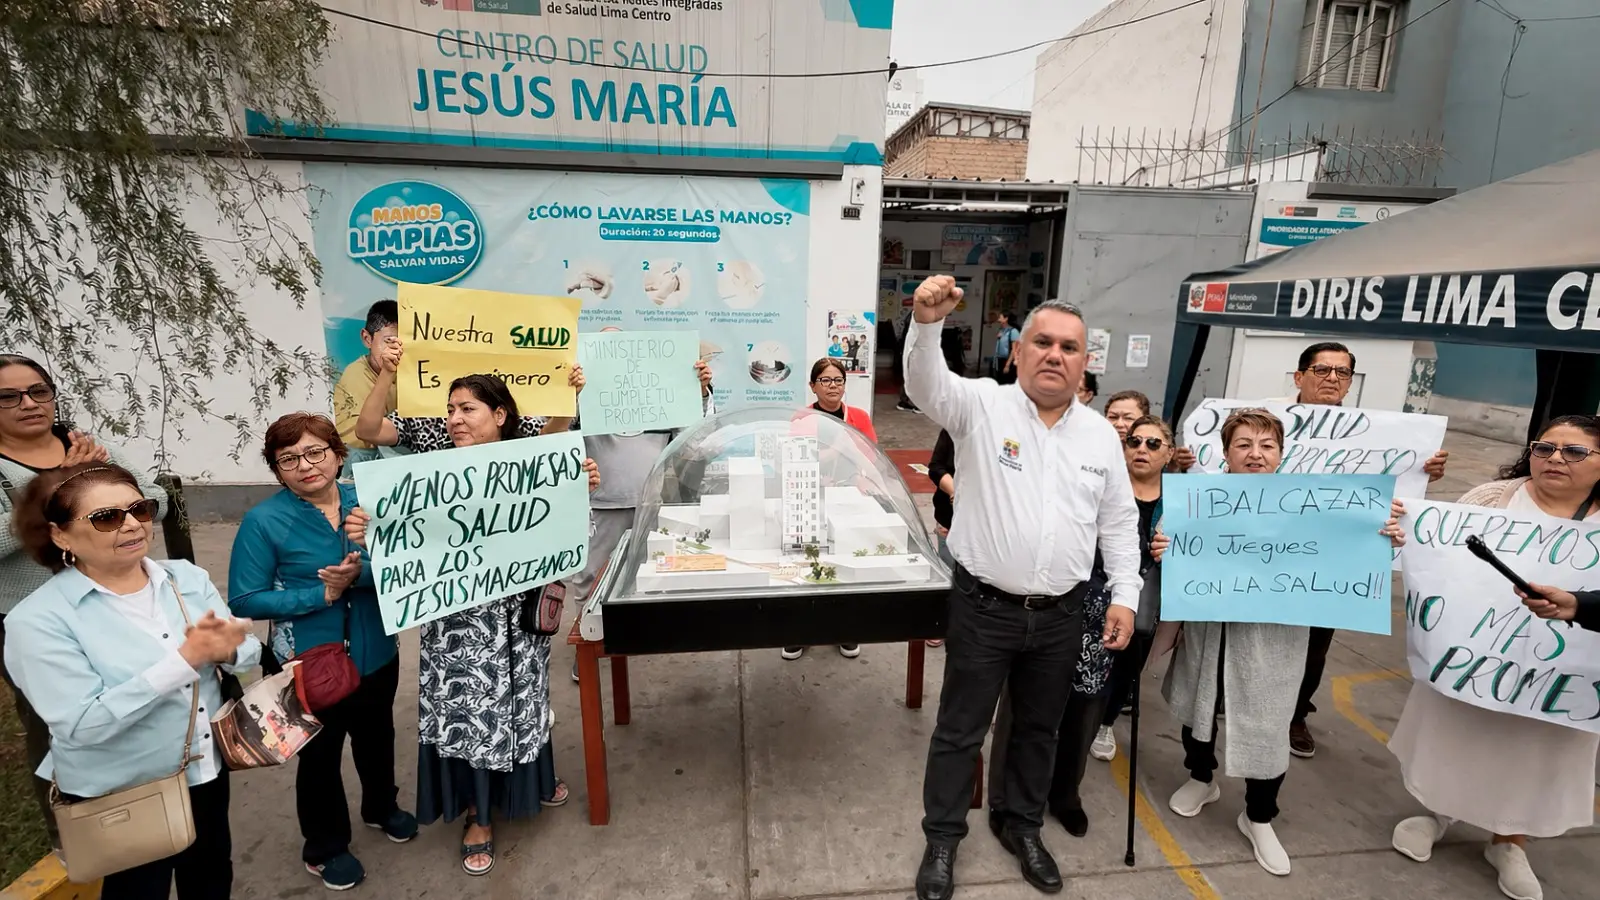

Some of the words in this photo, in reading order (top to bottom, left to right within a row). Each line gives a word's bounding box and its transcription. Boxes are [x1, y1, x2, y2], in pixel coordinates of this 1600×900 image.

[547, 2, 562, 14] de
[565, 3, 597, 17] Salud
[600, 5, 629, 19] Lima
[632, 7, 671, 22] Centro
[436, 28, 557, 64] CENTRO
[567, 37, 604, 67] DE
[613, 40, 708, 73] SALUD
[413, 62, 556, 119] JESÚS
[571, 73, 737, 127] MARÍA
[372, 204, 443, 224] MANOS
[527, 201, 593, 221] ¿CÓMO
[597, 207, 678, 222] LAVARSE
[682, 209, 715, 223] LAS
[720, 210, 793, 226] MANOS?
[348, 222, 473, 256] LIMPIAS
[600, 227, 651, 238] Duración:
[653, 229, 666, 238] 20
[379, 257, 426, 269] SALVAN
[429, 255, 465, 266] VIDAS
[563, 260, 569, 269] 1
[642, 261, 650, 270] 2
[717, 263, 724, 272] 3
[1236, 302, 1253, 311] Salud
[1290, 275, 1385, 322] DIRIS
[1401, 274, 1516, 328] LIMA
[510, 325, 571, 347] SALUD
[584, 339, 676, 360] MINISTERIO
[747, 343, 754, 352] 7
[417, 359, 442, 389] Es
[626, 360, 642, 374] DE
[613, 372, 660, 390] SALUD
[600, 388, 653, 407] CUMPLE
[655, 387, 675, 404] TU
[604, 406, 668, 428] PROMESA
[1285, 404, 1371, 441] SALUD
[376, 466, 477, 519] MENOS
[484, 447, 581, 499] PROMESAS
[370, 515, 425, 557] MÁS
[447, 497, 551, 547] SALUD
[1413, 506, 1600, 570] QUEREMOS
[1171, 531, 1204, 557] NO
[380, 559, 426, 595] PARA
[437, 545, 483, 577] LOS
[1183, 578, 1222, 596] CON
[1233, 576, 1262, 594] LA
[1405, 589, 1446, 632] NO
